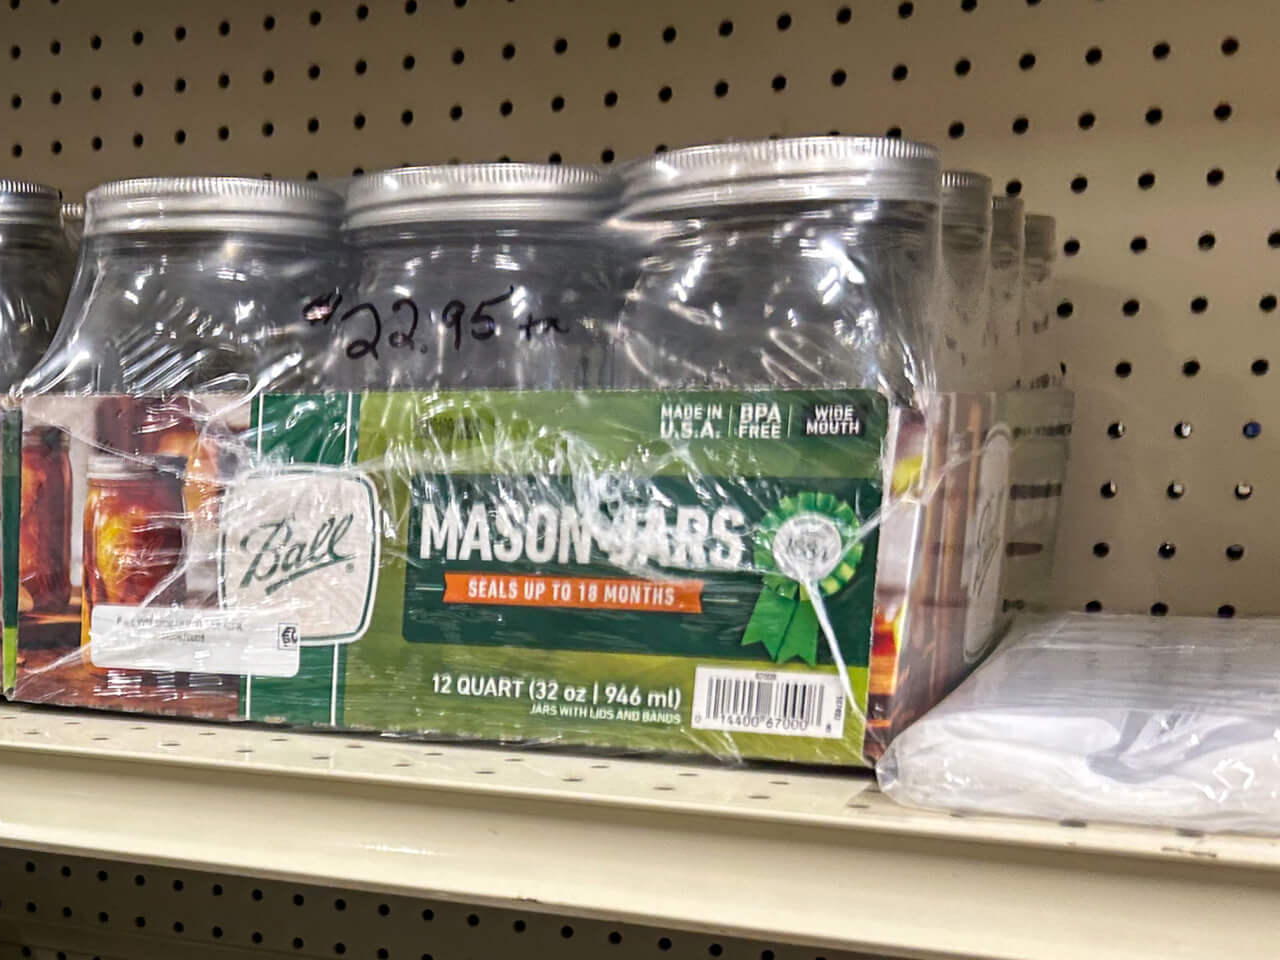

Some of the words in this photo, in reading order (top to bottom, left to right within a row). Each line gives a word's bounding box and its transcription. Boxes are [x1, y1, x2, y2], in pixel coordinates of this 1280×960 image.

[660, 403, 703, 419] MADE
[707, 404, 722, 420] IN
[740, 403, 782, 423] BPA
[814, 405, 855, 421] WIDE
[660, 420, 721, 439] U.S.A.
[738, 424, 782, 439] FREE
[806, 420, 860, 435] MOUTH
[419, 503, 592, 565] MASON
[240, 513, 357, 596] Ball
[468, 578, 518, 600] SEALS
[524, 580, 544, 600] UP
[550, 582, 570, 601] TO
[577, 582, 597, 602] 18
[603, 583, 676, 606] MONTHS
[431, 674, 451, 695] 12
[457, 676, 525, 698] QUART
[528, 678, 557, 703] (32
[564, 687, 587, 703] oz
[605, 685, 641, 707] 946
[647, 686, 681, 711] ml)
[529, 704, 557, 718] JARS
[559, 706, 587, 719] WITH
[589, 708, 613, 720] LIDS
[616, 709, 639, 721] AND
[642, 711, 681, 725] BANDS
[720, 714, 759, 728] 14400
[766, 716, 808, 732] 67000
